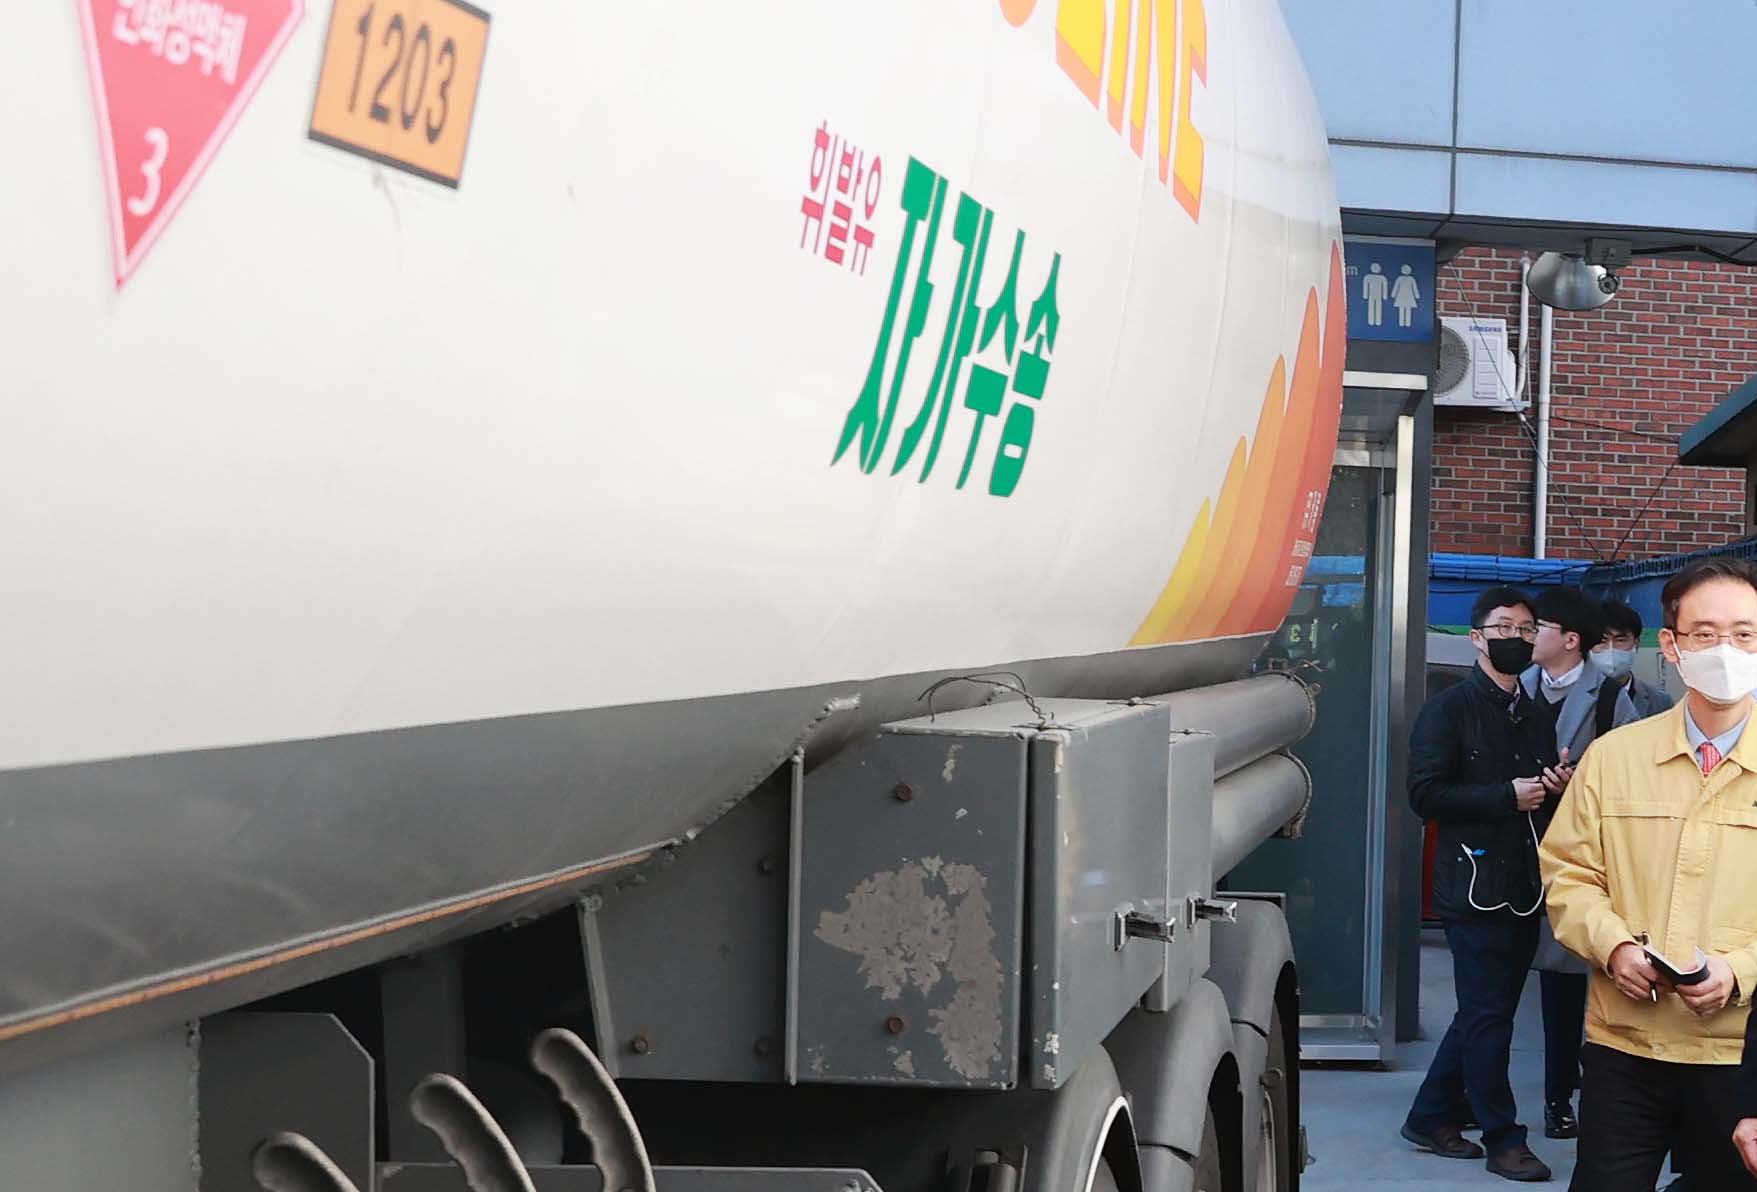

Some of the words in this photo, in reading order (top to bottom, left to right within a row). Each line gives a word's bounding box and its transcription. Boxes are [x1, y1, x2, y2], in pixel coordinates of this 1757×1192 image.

[349, 3, 458, 145] 1203
[128, 127, 169, 217] 3
[800, 119, 882, 277] 휘발유
[829, 154, 1062, 499] 자가수송
